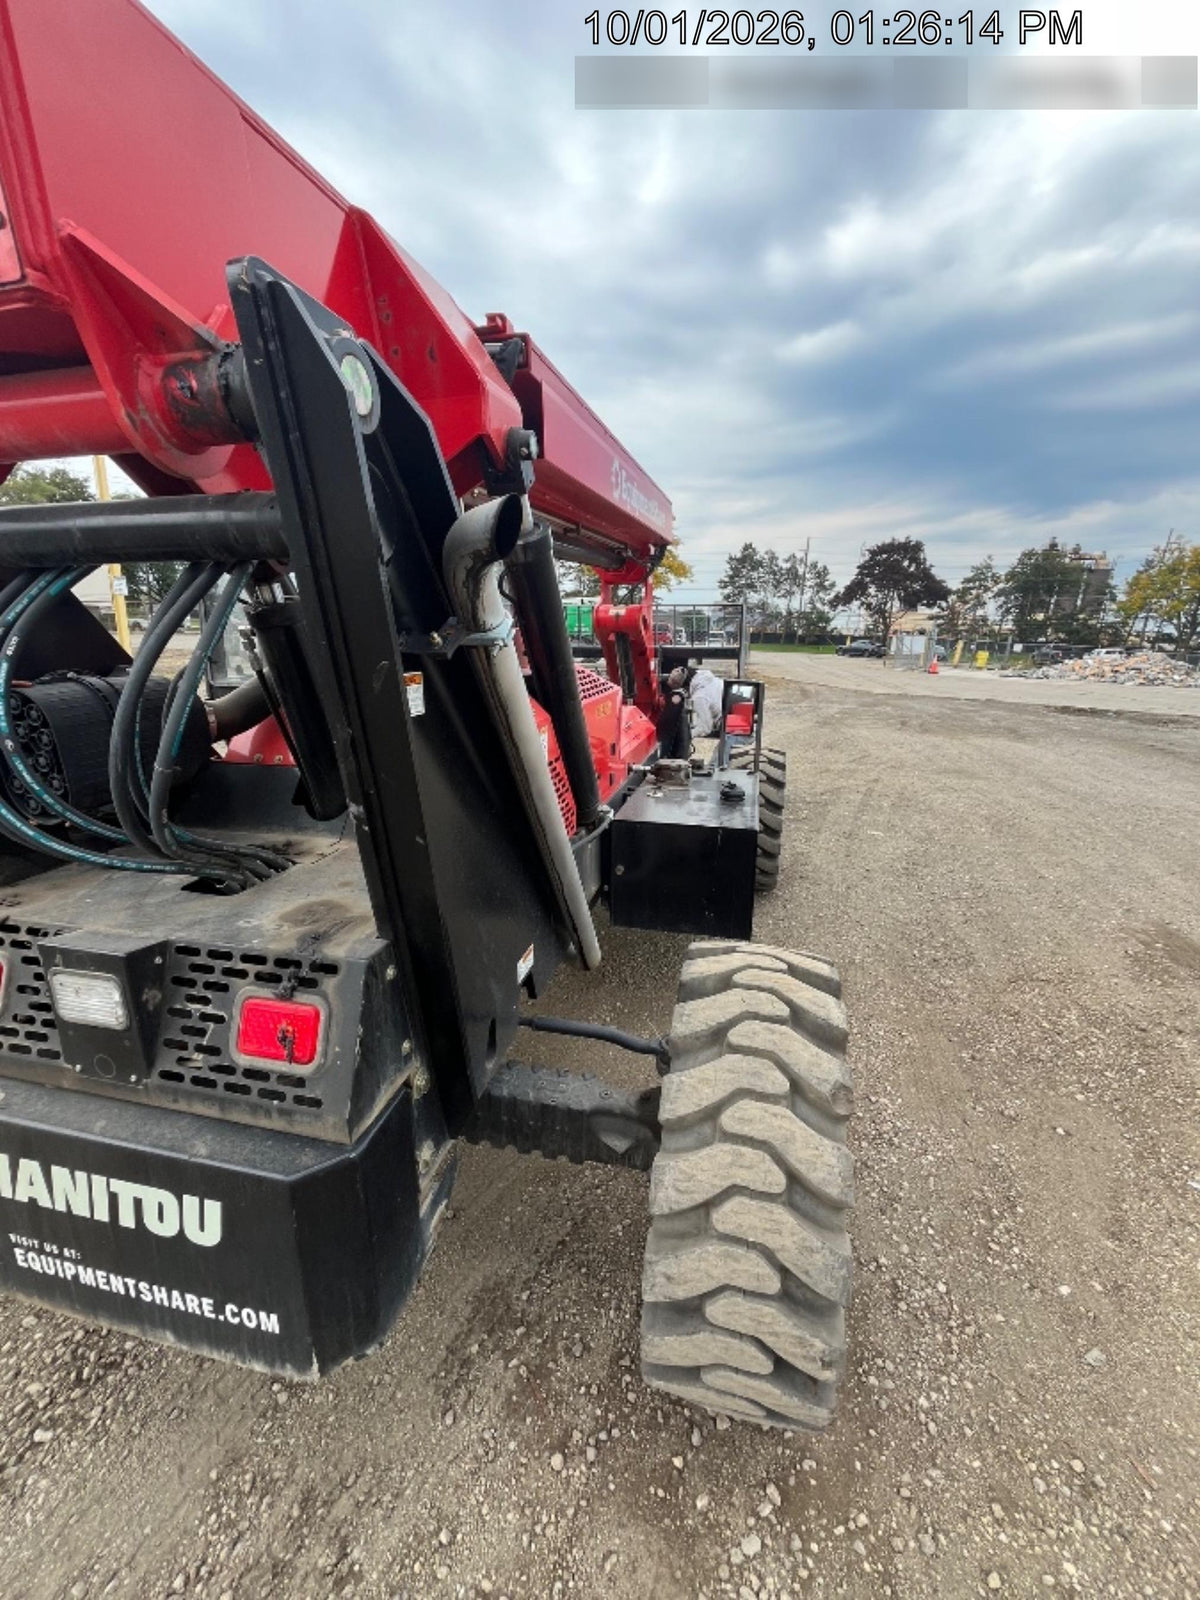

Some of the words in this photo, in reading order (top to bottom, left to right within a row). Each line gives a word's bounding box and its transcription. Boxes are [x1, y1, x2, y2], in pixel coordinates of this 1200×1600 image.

[8, 1233, 39, 1249] VISIT
[43, 1242, 59, 1254] US
[63, 1247, 81, 1260] AT:
[13, 1247, 280, 1334] EQUIPMENTSHARE.COM
